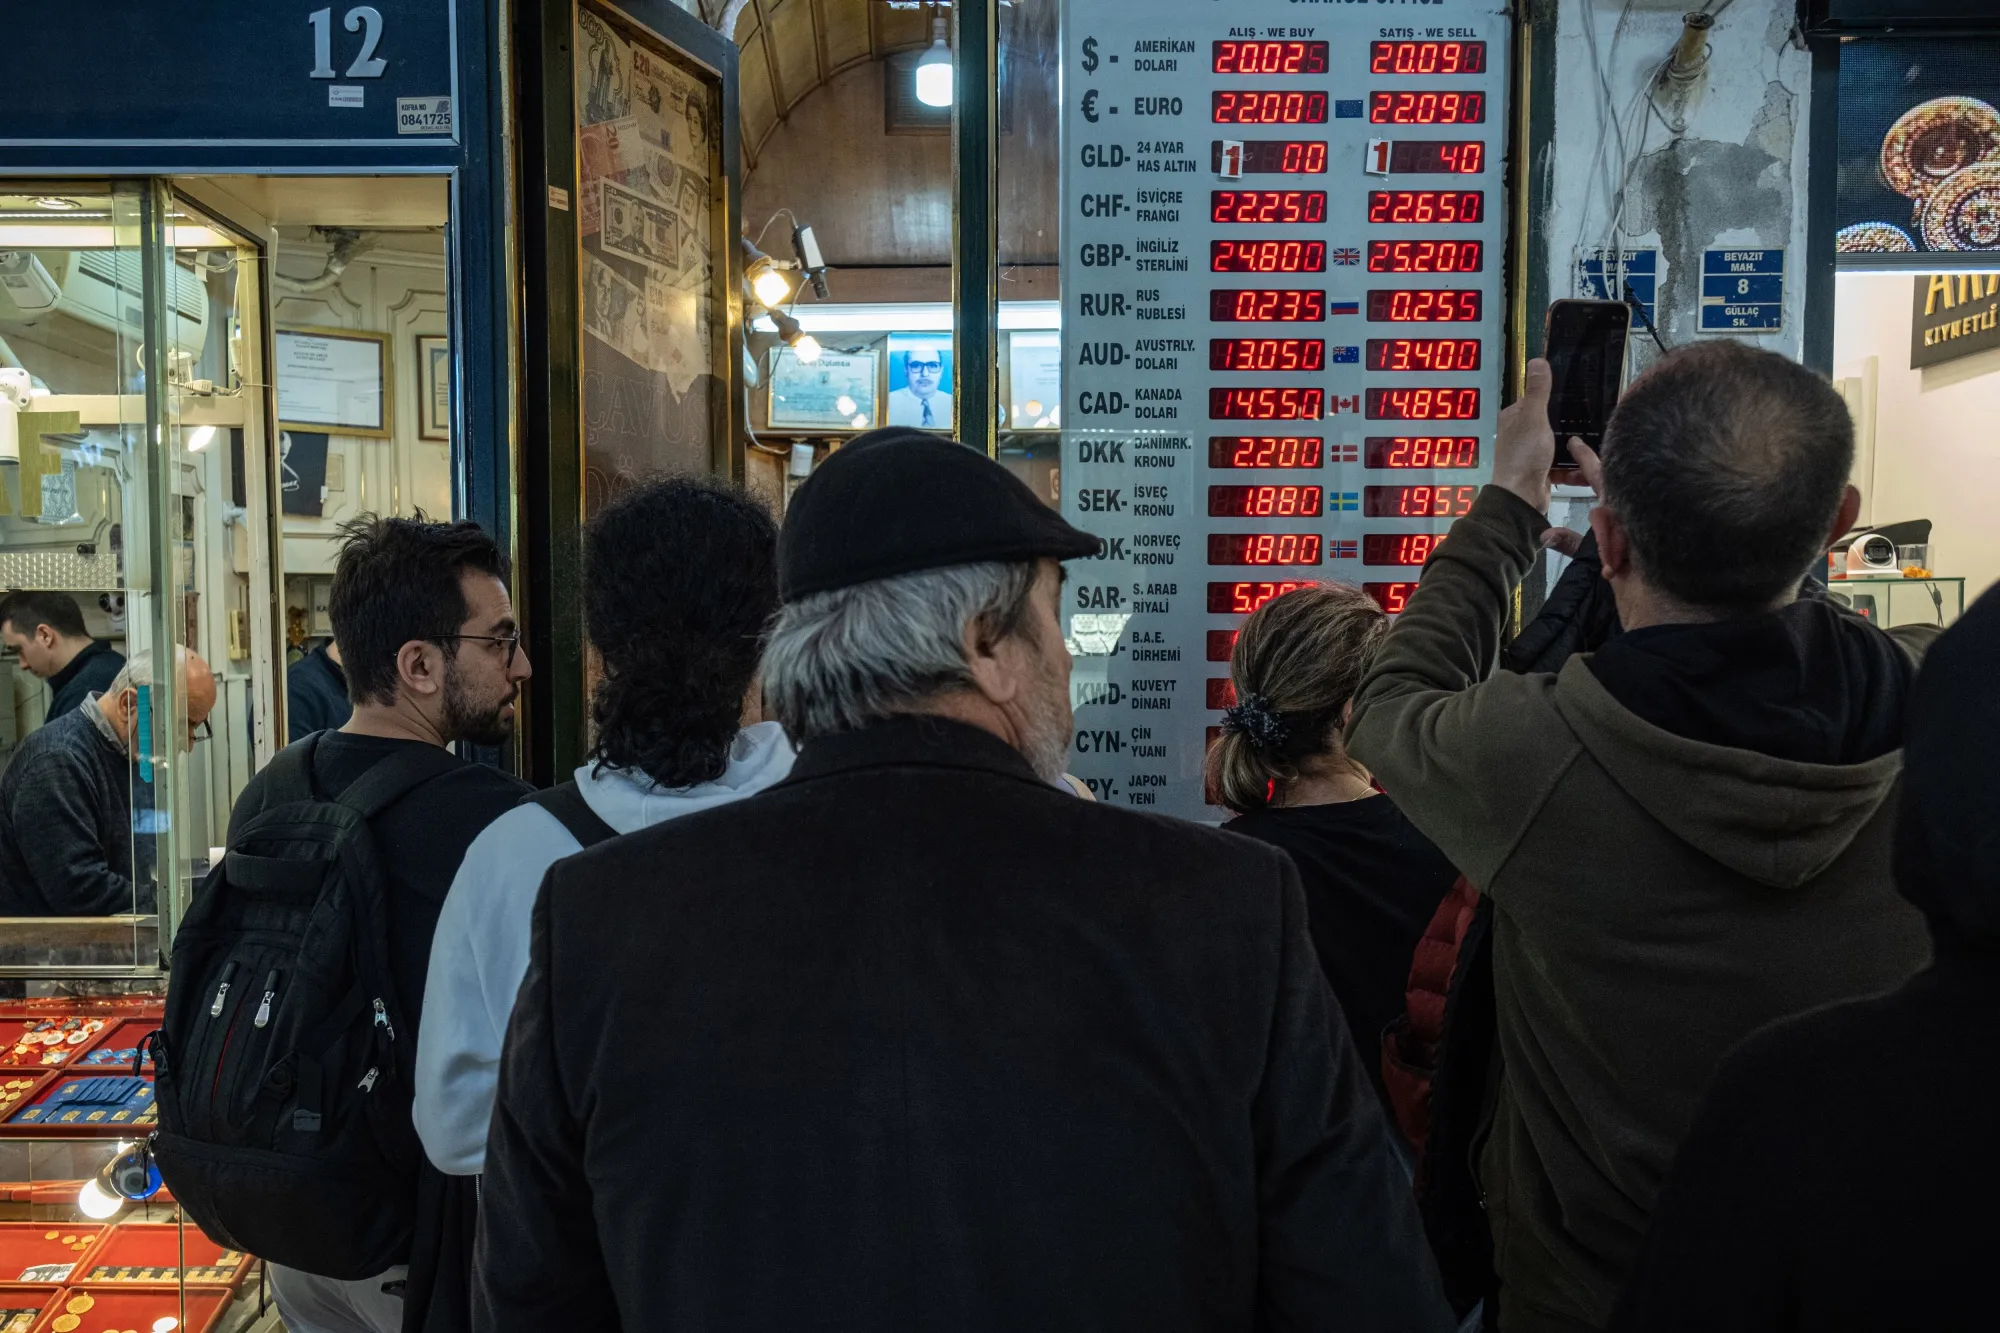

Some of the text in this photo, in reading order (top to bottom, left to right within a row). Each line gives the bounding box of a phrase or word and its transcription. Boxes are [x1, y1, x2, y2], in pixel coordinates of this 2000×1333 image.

[308, 6, 388, 79] 12
[1229, 28, 1255, 39] ALIŞ
[1268, 28, 1285, 37] WE
[1290, 28, 1314, 37] BUY
[1380, 28, 1413, 40] SATIŞ
[1426, 28, 1443, 37] WE
[1448, 28, 1476, 37] SELL
[1135, 37, 1194, 52] AMERİKAN
[1082, 36, 1098, 76] $
[1135, 59, 1176, 71] DOLARI
[1216, 43, 1324, 73] 20.025
[1372, 43, 1480, 73] 20.090
[1081, 89, 1099, 123] €
[1135, 97, 1182, 115] EURO
[1215, 93, 1324, 123] 22.000
[1371, 93, 1481, 123] 22.090
[401, 113, 451, 126] 0841725
[1081, 144, 1130, 167] GLD-
[1137, 142, 1183, 153] 24 AYAR
[1137, 160, 1196, 172] HAS ALTIN
[1282, 144, 1325, 172] 00
[1371, 141, 1480, 173] 1 40
[1081, 194, 1130, 217] CHF-
[1137, 188, 1182, 206] İSVİÇRE
[1137, 210, 1179, 222] FRANGI
[1214, 192, 1324, 222] 22.250
[1370, 192, 1479, 222] 22.650
[1137, 237, 1178, 252] İNGİLİZ
[1081, 244, 1130, 266] GBP-
[1137, 256, 1187, 271] STERLİNİ
[1214, 242, 1323, 271] 24.800
[1369, 242, 1478, 271] 25.200
[1724, 252, 1763, 262] BEYAZIT
[1730, 263, 1756, 272] MAH.
[1137, 290, 1159, 301] RUS
[1737, 279, 1749, 294] 8
[1081, 294, 1131, 316] RUR-
[1137, 305, 1185, 320] RUBLESİ
[1235, 291, 1321, 320] 0.235
[1389, 291, 1476, 320] 0.255
[1725, 306, 1759, 318] GÜLLAÇ
[1732, 318, 1749, 327] SK.
[1079, 343, 1130, 365] AUD-
[1135, 340, 1195, 351] AVUSTRLY.
[1225, 340, 1322, 369] 13.050
[1136, 358, 1177, 369] DOLARI
[1380, 340, 1477, 370] 13.400
[1079, 392, 1129, 414] CAD-
[1136, 389, 1182, 400] KANADA
[1380, 389, 1476, 418] 14.850
[1135, 407, 1177, 418] DOLARI
[1225, 389, 1321, 419] 14.550
[1135, 435, 1191, 449] DANİMRK.
[1079, 441, 1124, 463] DKK
[1233, 437, 1320, 467] 2.200
[1387, 437, 1475, 468] 2.800
[1135, 456, 1175, 467] KRONU
[1078, 489, 1127, 511] SEK-
[1135, 483, 1167, 501] İSVEÇ
[1245, 486, 1319, 515] 1.880
[1400, 486, 1473, 516] 1.955
[1134, 505, 1174, 516] KRONU
[1082, 537, 1131, 560] OK-
[1134, 535, 1180, 550] NORVEÇ
[1245, 535, 1319, 564] 1.800
[1399, 535, 1448, 564] 1.8
[1134, 553, 1173, 564] KRONU
[1077, 586, 1126, 608] SAR-
[1133, 583, 1177, 595] S. ARAB
[1133, 598, 1168, 613] RİYALİ
[1133, 632, 1164, 643] B.A.E.
[1133, 647, 1180, 661] DİRHEMİ
[1077, 682, 1127, 705] KWD-
[1132, 680, 1176, 691] KUVEYT
[1132, 695, 1170, 709] DİNARI
[1076, 731, 1127, 753] CYN-
[1131, 725, 1150, 742] ÇİN
[1131, 746, 1166, 757] YUANI
[1079, 779, 1118, 800] PY-
[1129, 775, 1166, 786] JAPON
[1129, 790, 1155, 804] YENİ
